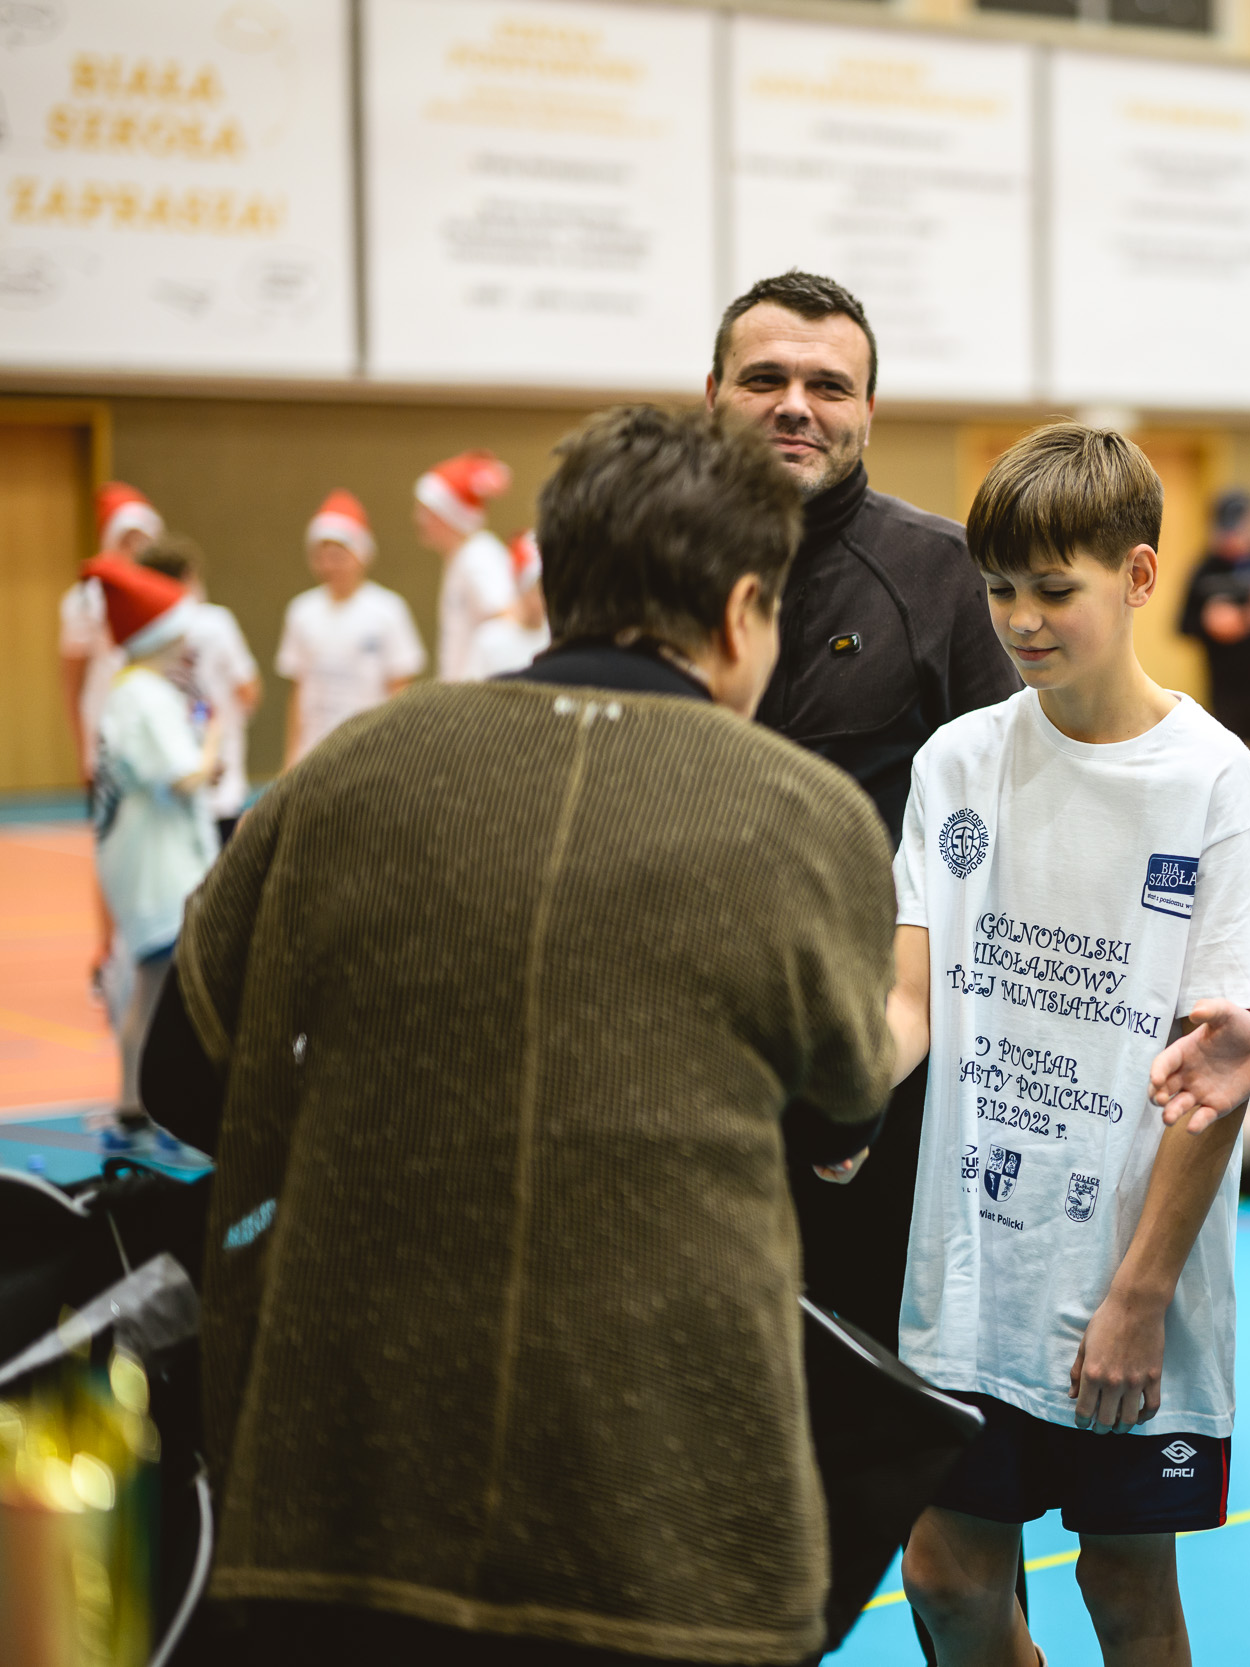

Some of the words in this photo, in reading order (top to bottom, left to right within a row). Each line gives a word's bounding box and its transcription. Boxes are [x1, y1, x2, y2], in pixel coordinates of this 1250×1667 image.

[976, 912, 1132, 965] GÓLNOPOLSKI
[998, 1037, 1079, 1084] PUCHAR
[977, 1096, 1050, 1136] 3.12.2022
[1016, 1074, 1123, 1124] POLICKIEO
[980, 1209, 996, 1222] wiat
[997, 1213, 1024, 1231] Policki
